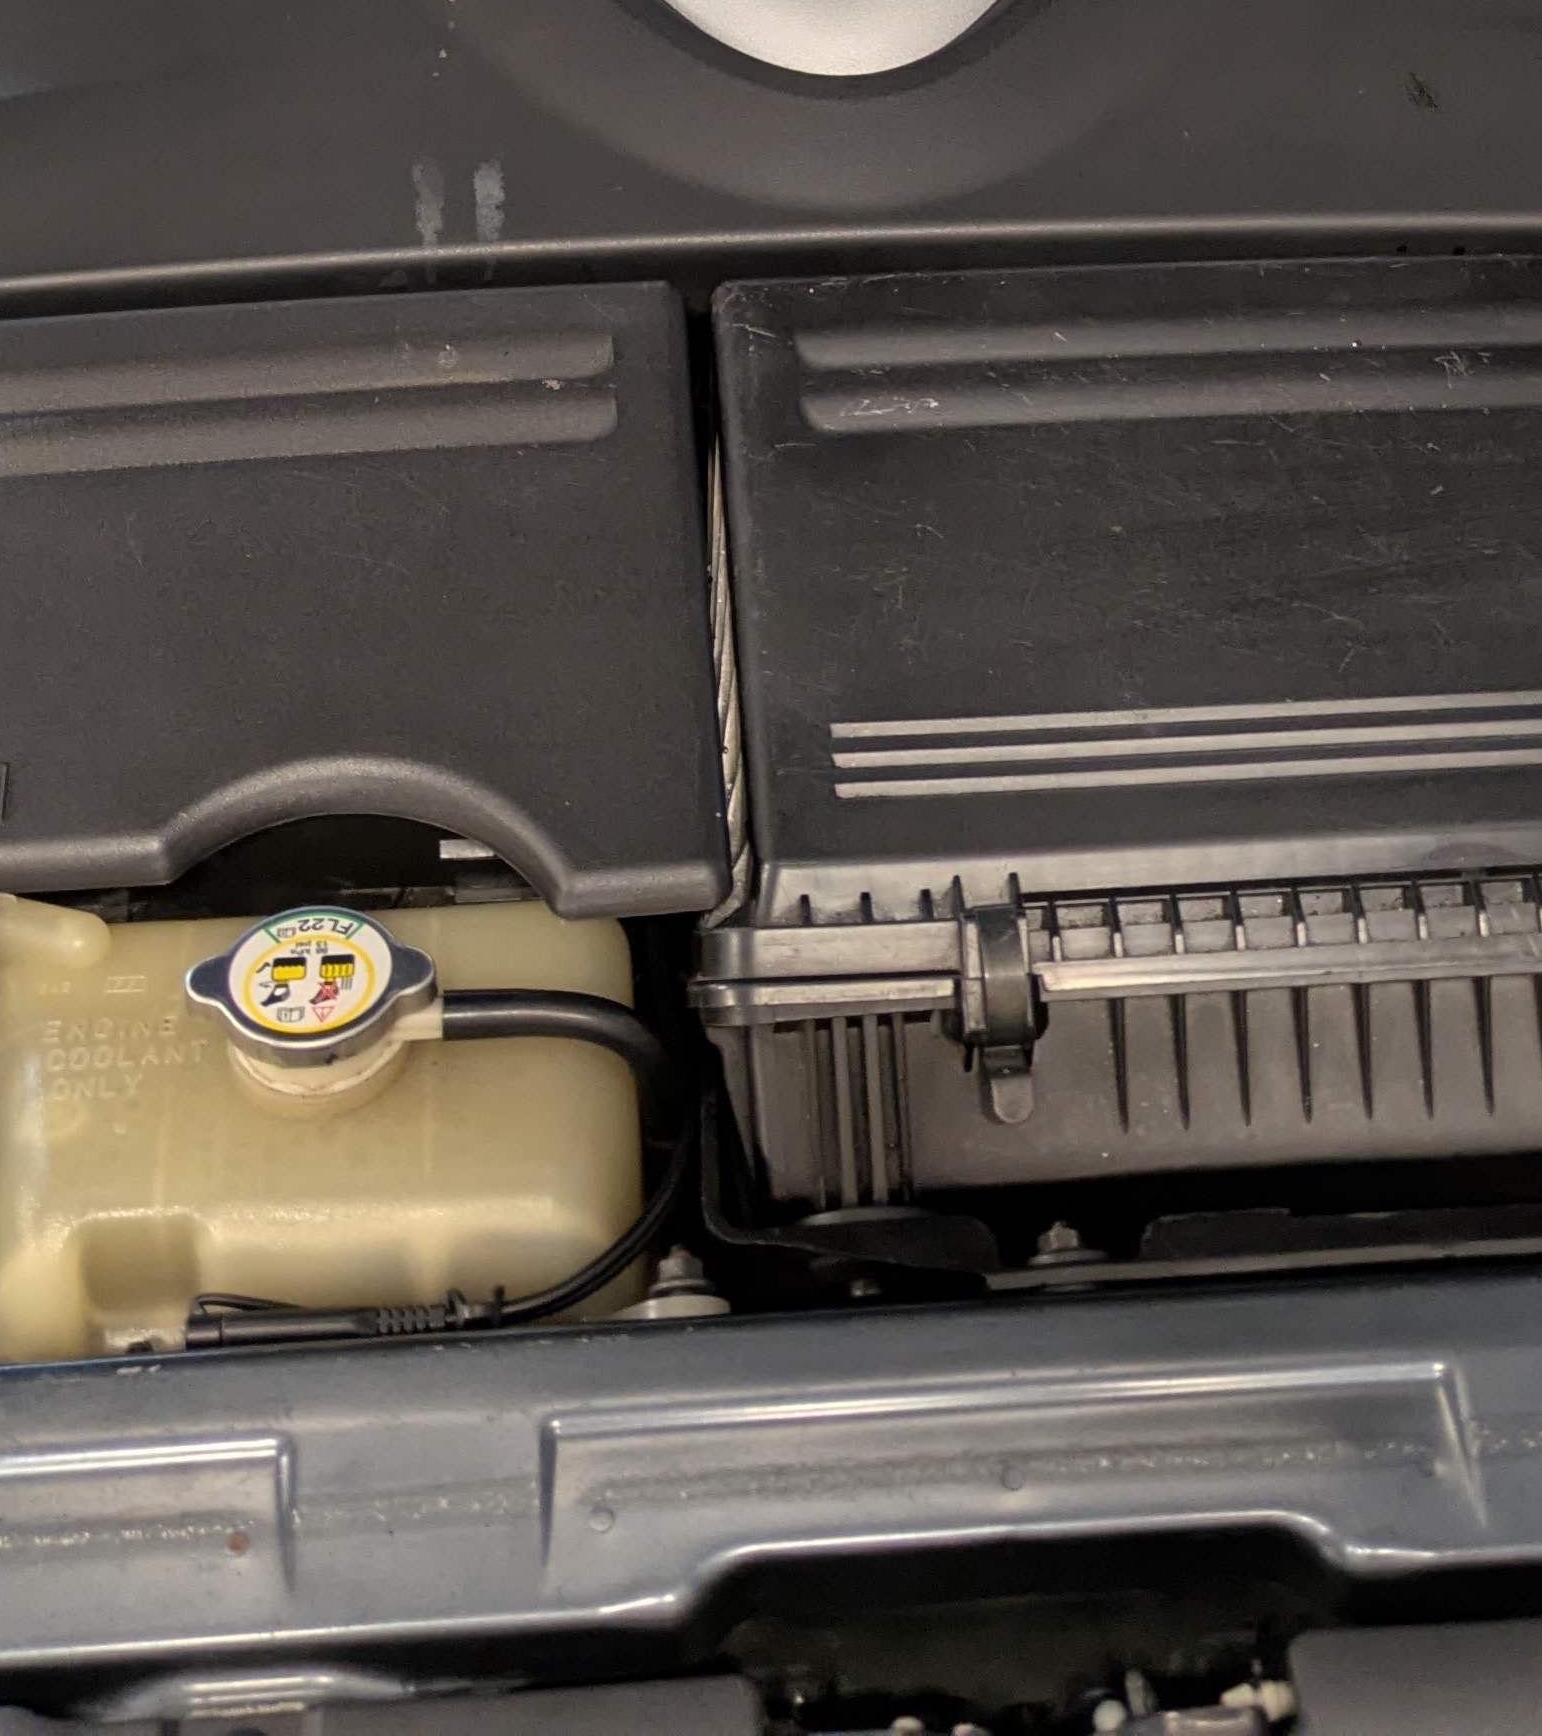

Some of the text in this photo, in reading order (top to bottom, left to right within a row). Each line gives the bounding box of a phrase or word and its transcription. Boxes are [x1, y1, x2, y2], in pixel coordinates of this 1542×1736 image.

[298, 917, 354, 935] FL22
[41, 1015, 177, 1043] ENGINE
[47, 1039, 209, 1072] COOLANT
[51, 1074, 144, 1101] ONLY
